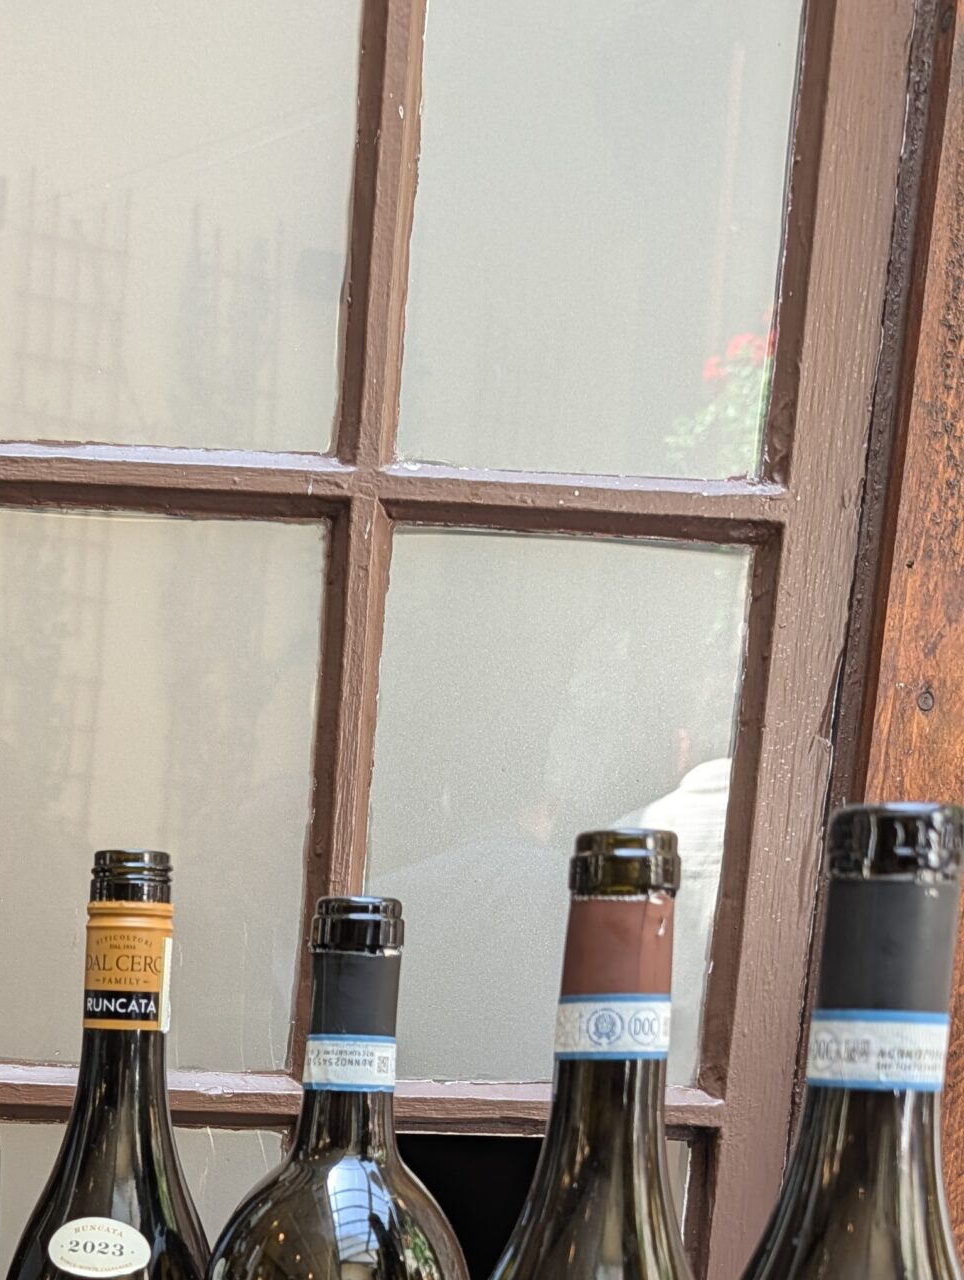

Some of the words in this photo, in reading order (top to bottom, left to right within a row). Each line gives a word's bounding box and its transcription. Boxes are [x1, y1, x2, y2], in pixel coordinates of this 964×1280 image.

[102, 976, 141, 985] FAMILY
[86, 998, 157, 1014] RUNCATA
[74, 1225, 123, 1237] RUNCATA
[68, 1239, 125, 1257] 2023
